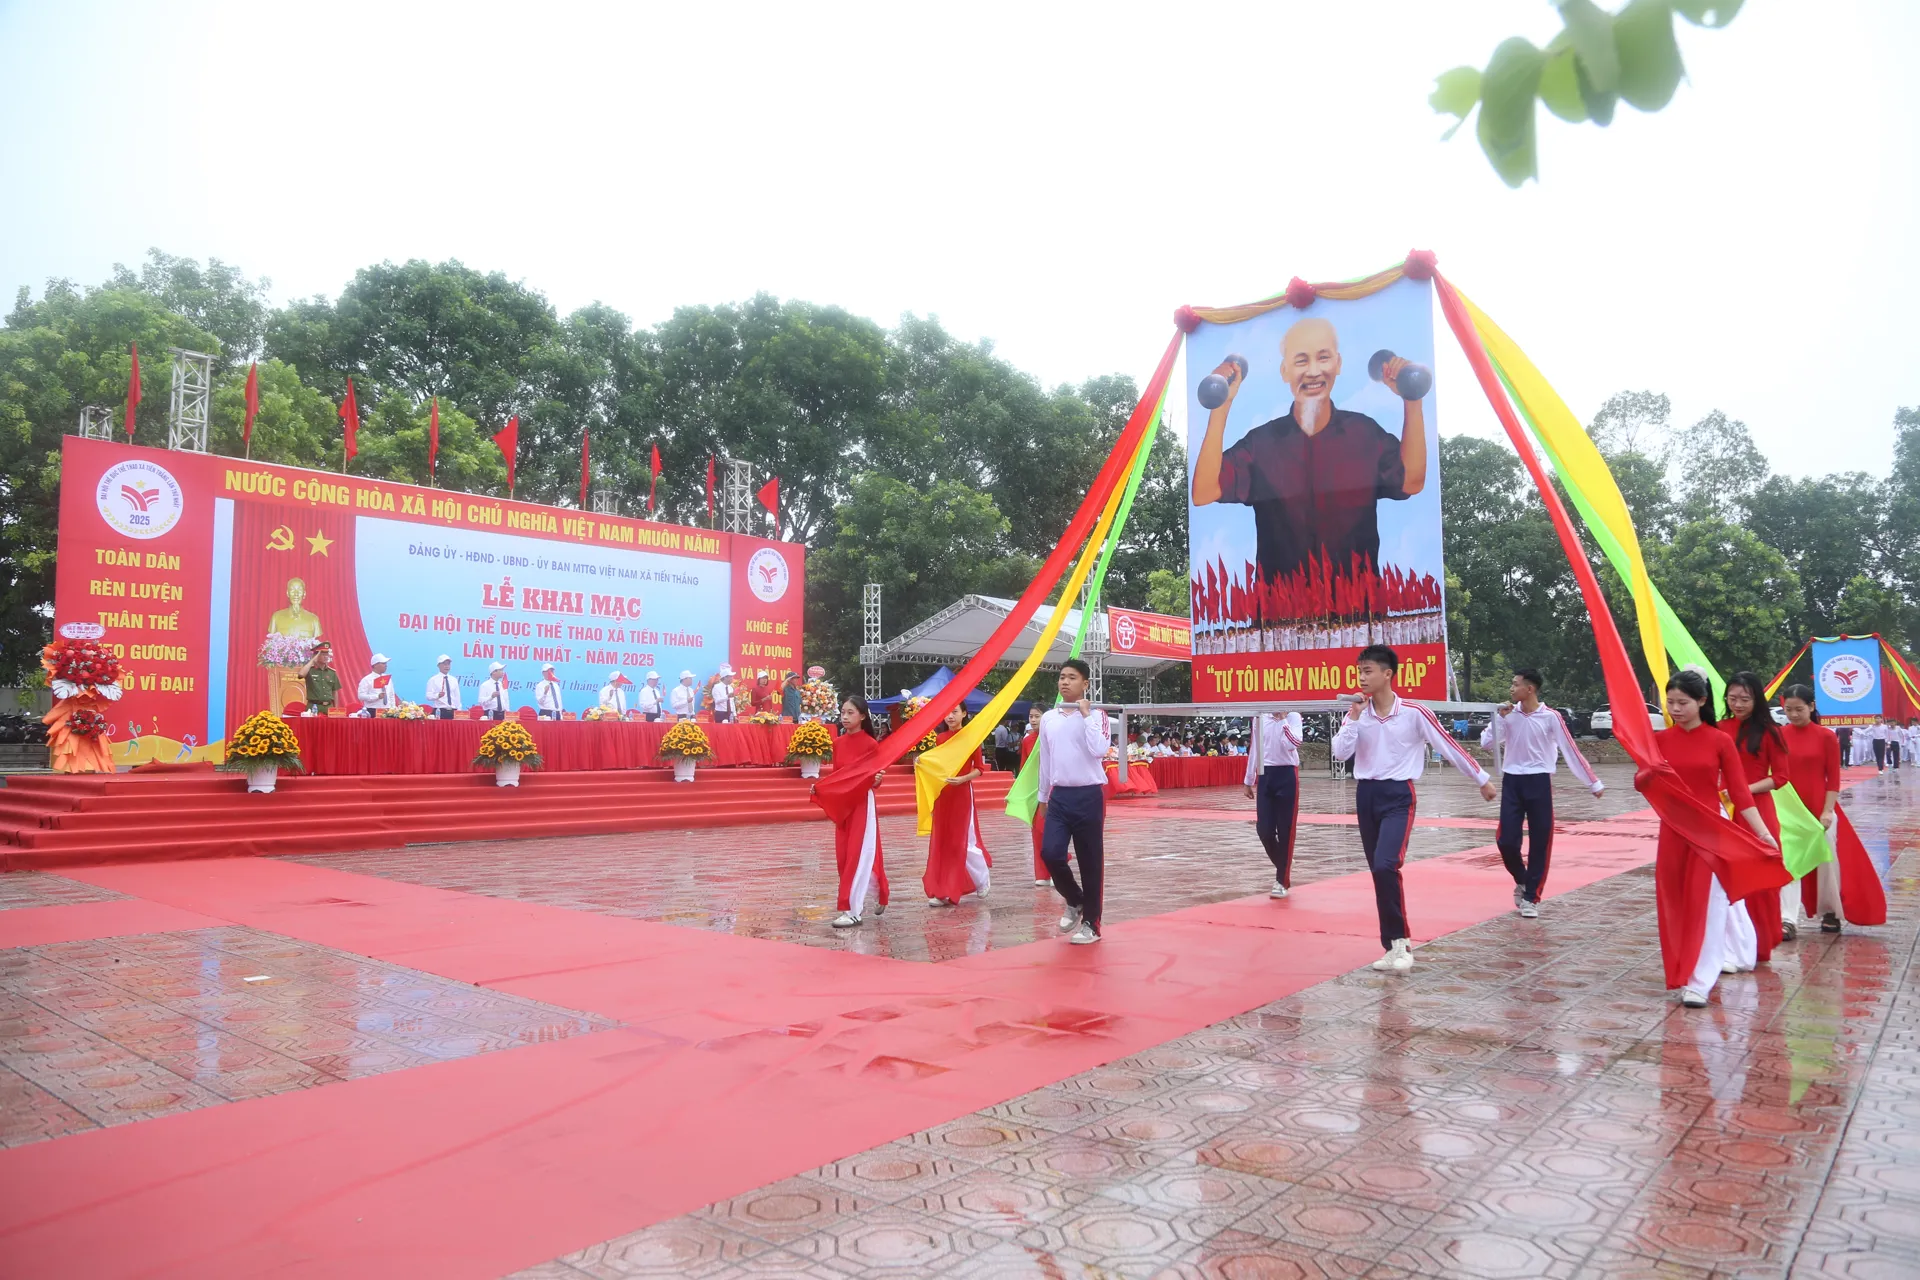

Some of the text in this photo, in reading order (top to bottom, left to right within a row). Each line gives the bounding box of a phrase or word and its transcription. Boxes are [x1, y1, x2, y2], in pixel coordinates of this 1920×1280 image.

[130, 514, 150, 526] 2025
[225, 470, 720, 555] NƯỚC CỘNG HÒA XÃ HỘI CHỦ NGHĨA VIỆT NAM MUÔN NĂM!
[95, 548, 180, 571] TOÀN DÂN
[409, 542, 440, 558] ĐẢNG
[444, 545, 457, 560] ỦY
[465, 551, 495, 564] HĐND
[503, 555, 529, 567] UBND
[537, 556, 549, 570] ỦY
[551, 560, 570, 572] BAN
[573, 563, 597, 576] MTTQ
[599, 564, 616, 580] VIỆT
[618, 568, 638, 580] NAM
[640, 569, 652, 581] XÃ
[654, 569, 670, 583] TIẾN
[672, 571, 699, 586] THẮNG
[90, 578, 183, 603] RÈN LUYỆN
[483, 576, 642, 622] LỄ KHAI MẠC
[98, 610, 180, 631] THÂN THỂ
[399, 612, 704, 648] ĐẠI HỘI THỂ DỤC THỂ THAO XÃ TIẾN THẮNG
[746, 617, 790, 635] KHỎE ĐỂ
[130, 644, 187, 661] GƯƠNG
[463, 637, 495, 659] LẦN
[499, 642, 529, 661] THỨ
[533, 642, 572, 663] NHẤT
[586, 648, 619, 666] NĂM
[622, 652, 654, 667] 2025
[741, 642, 793, 660] XÂY DỰNG
[140, 673, 157, 691] VĨ
[160, 676, 194, 694] ĐẠI!
[740, 665, 754, 680] VÀ
[1236, 665, 1259, 692] TÔI
[1264, 663, 1304, 691] NGÀY
[1308, 661, 1341, 690] NÀO
[570, 680, 599, 693] tháng
